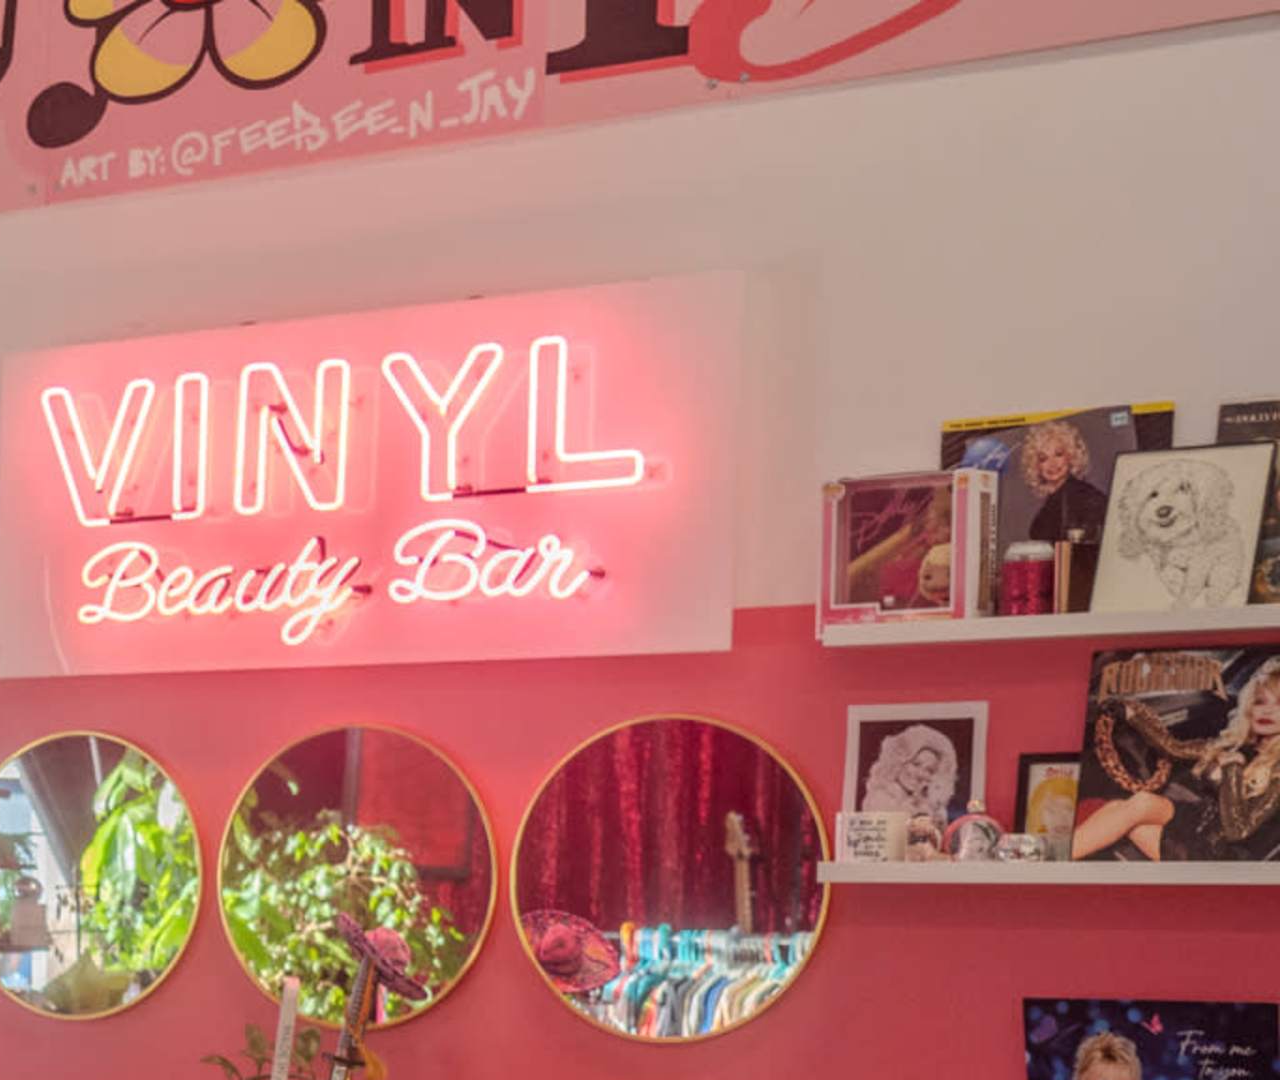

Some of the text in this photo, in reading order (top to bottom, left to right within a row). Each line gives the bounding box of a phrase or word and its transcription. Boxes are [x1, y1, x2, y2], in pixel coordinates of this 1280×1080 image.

[60, 151, 117, 188] ART
[127, 148, 167, 177] BY:
[41, 336, 645, 527] VINYL
[77, 518, 592, 645] Beauty Bar
[1176, 1029, 1225, 1057] From
